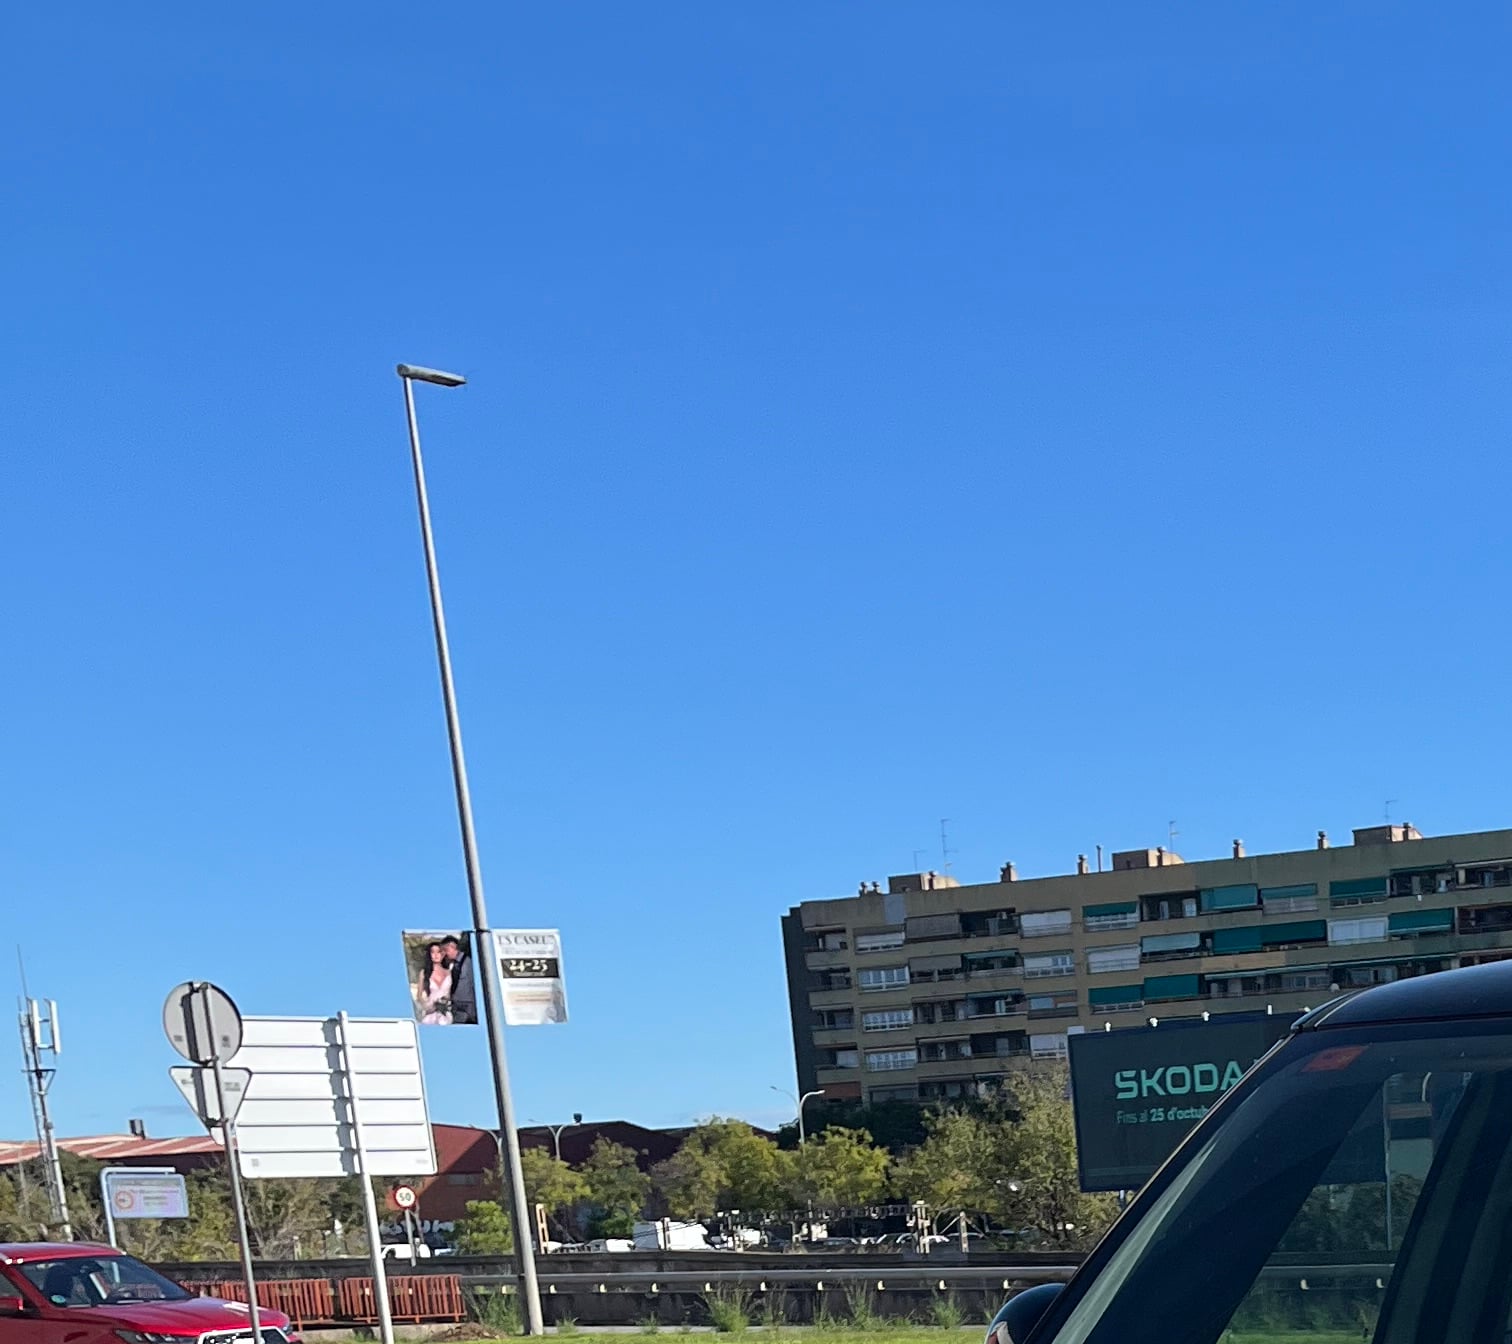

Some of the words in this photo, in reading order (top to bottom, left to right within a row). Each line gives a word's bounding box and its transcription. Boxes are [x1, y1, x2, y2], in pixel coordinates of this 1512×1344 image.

[509, 959, 548, 972] 24-25
[1114, 1060, 1245, 1099] SKODA
[1150, 1107, 1165, 1122] 25
